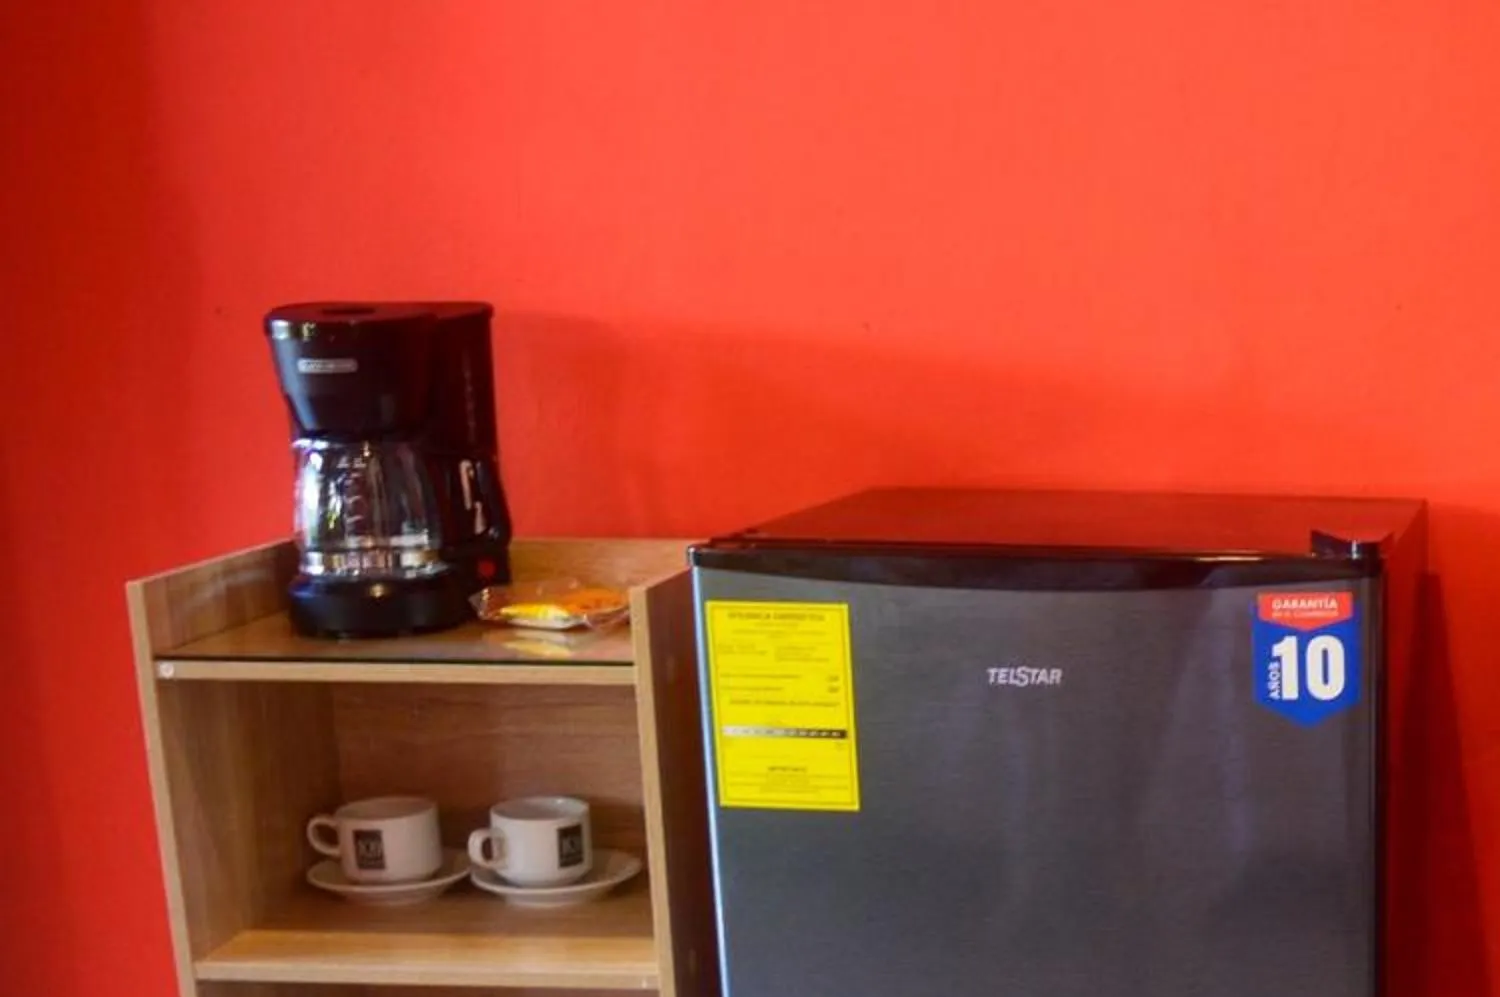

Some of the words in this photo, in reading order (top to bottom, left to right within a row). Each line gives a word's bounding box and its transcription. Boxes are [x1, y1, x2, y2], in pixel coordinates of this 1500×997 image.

[1271, 595, 1338, 609] GARANTÍA
[986, 665, 1063, 687] TELSTAR
[1266, 661, 1281, 700] AÑOS
[1272, 635, 1345, 701] 10
